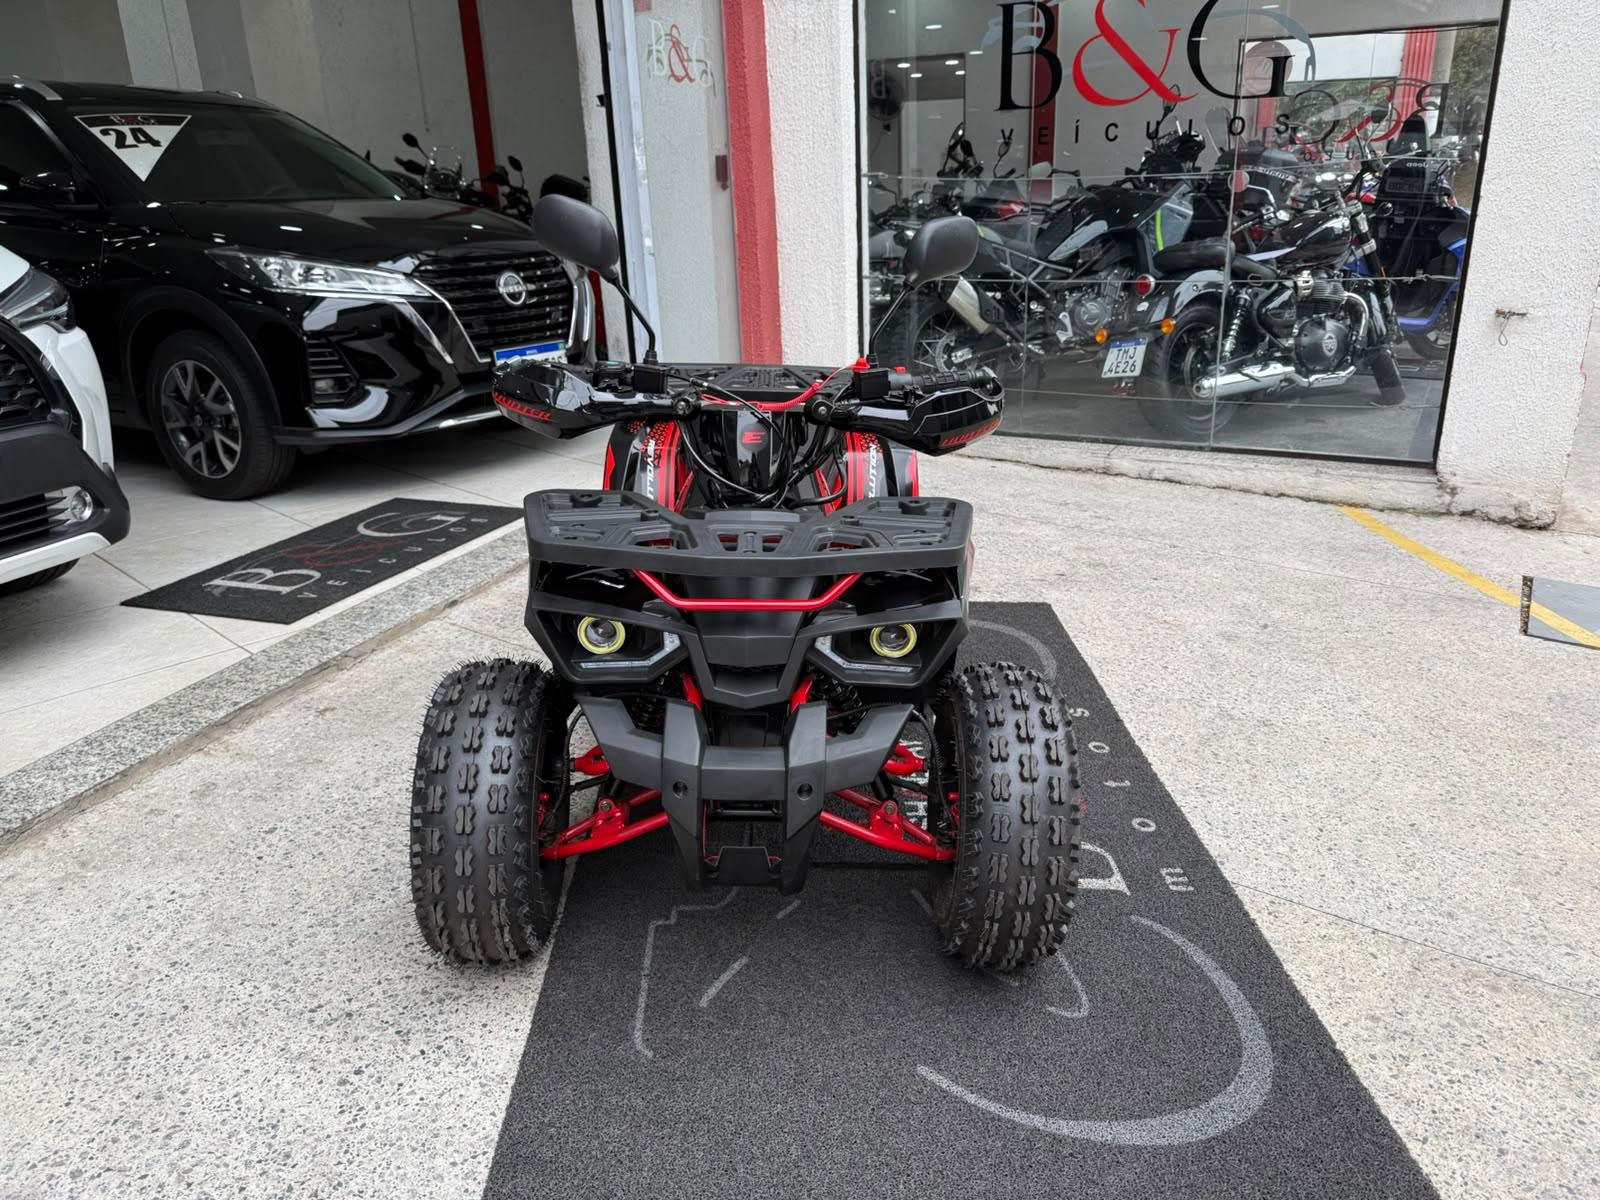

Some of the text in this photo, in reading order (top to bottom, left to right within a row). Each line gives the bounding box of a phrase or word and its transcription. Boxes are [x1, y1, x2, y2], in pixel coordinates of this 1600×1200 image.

[994, 0, 1296, 111] B&G
[99, 127, 163, 149] 24
[1001, 113, 1290, 146] VEÍCULOS
[1115, 347, 1137, 361] TMJ
[1107, 361, 1137, 374] 4E26
